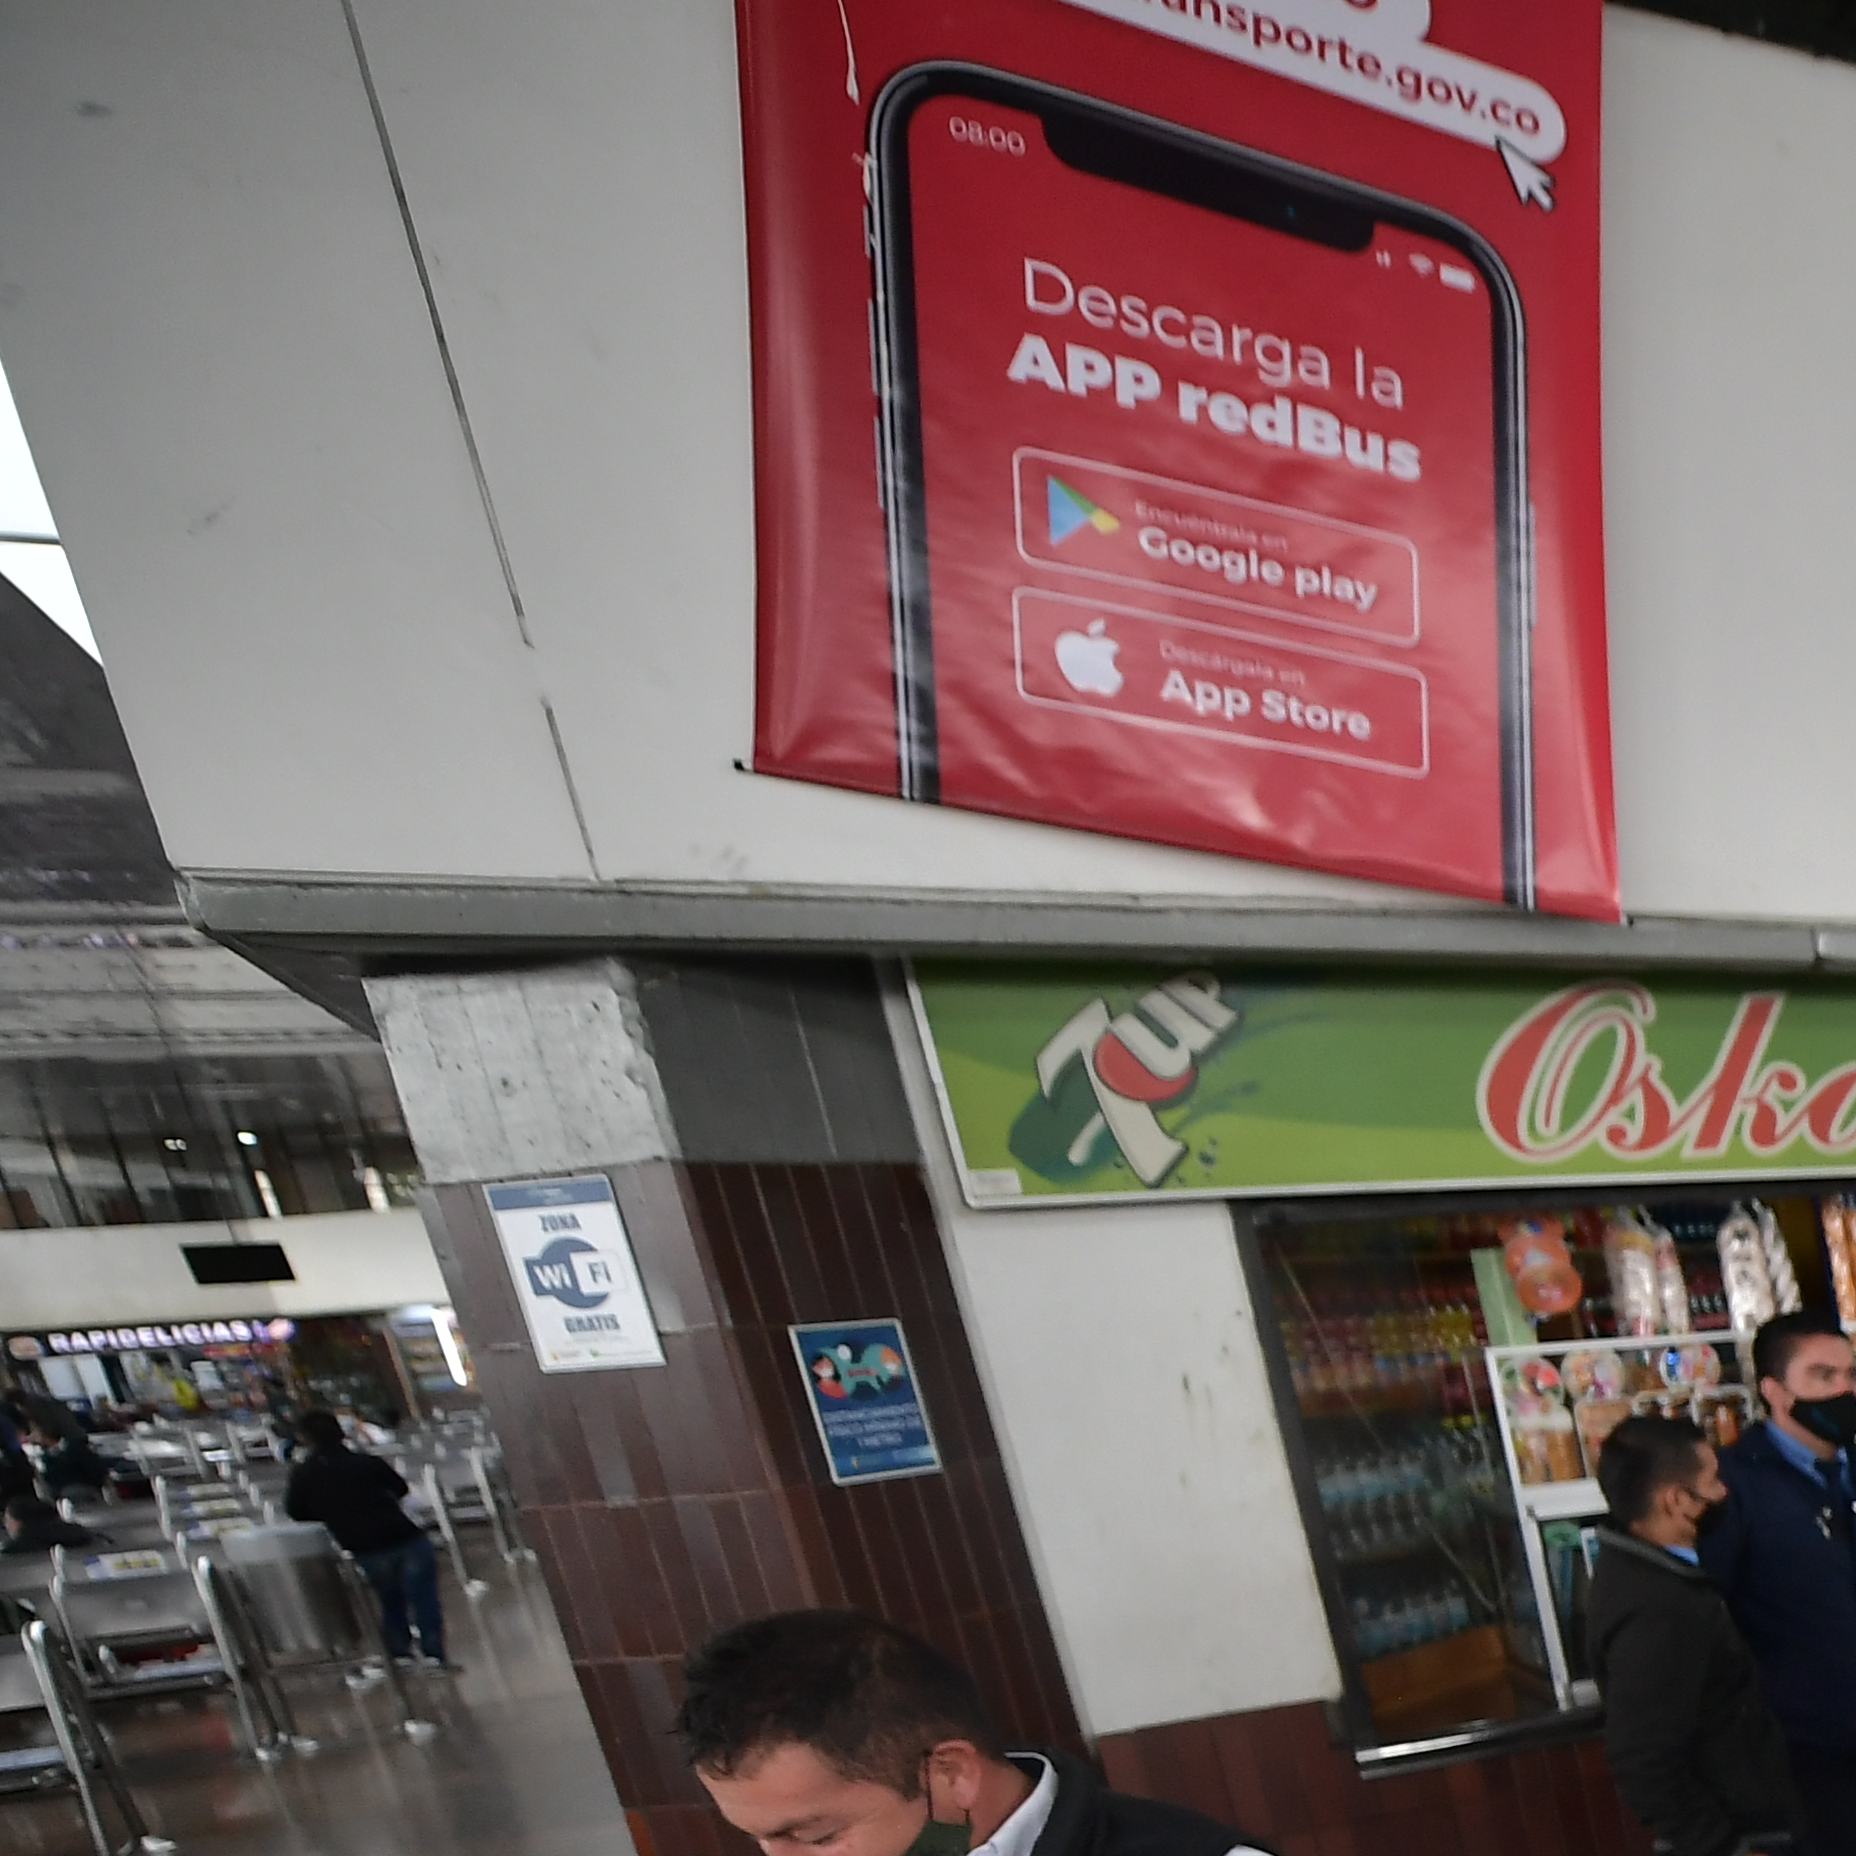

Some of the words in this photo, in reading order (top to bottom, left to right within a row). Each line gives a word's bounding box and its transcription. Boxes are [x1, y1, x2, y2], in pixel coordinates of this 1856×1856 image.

[1143, 0, 1540, 136] ansporte.gov.co
[949, 116, 1026, 157] 08:00
[1022, 257, 1331, 389] Descarga
[1354, 345, 1404, 410] la
[1006, 331, 1162, 409] APP
[1177, 379, 1422, 481] redBus
[1138, 526, 1286, 586] Google
[1295, 565, 1379, 613] play
[1159, 669, 1251, 722] App
[1261, 689, 1372, 742] Store
[538, 1212, 583, 1233] ZONA
[47, 1320, 252, 1353] RAPIDELICIAS
[563, 1313, 622, 1334] GRATIS
